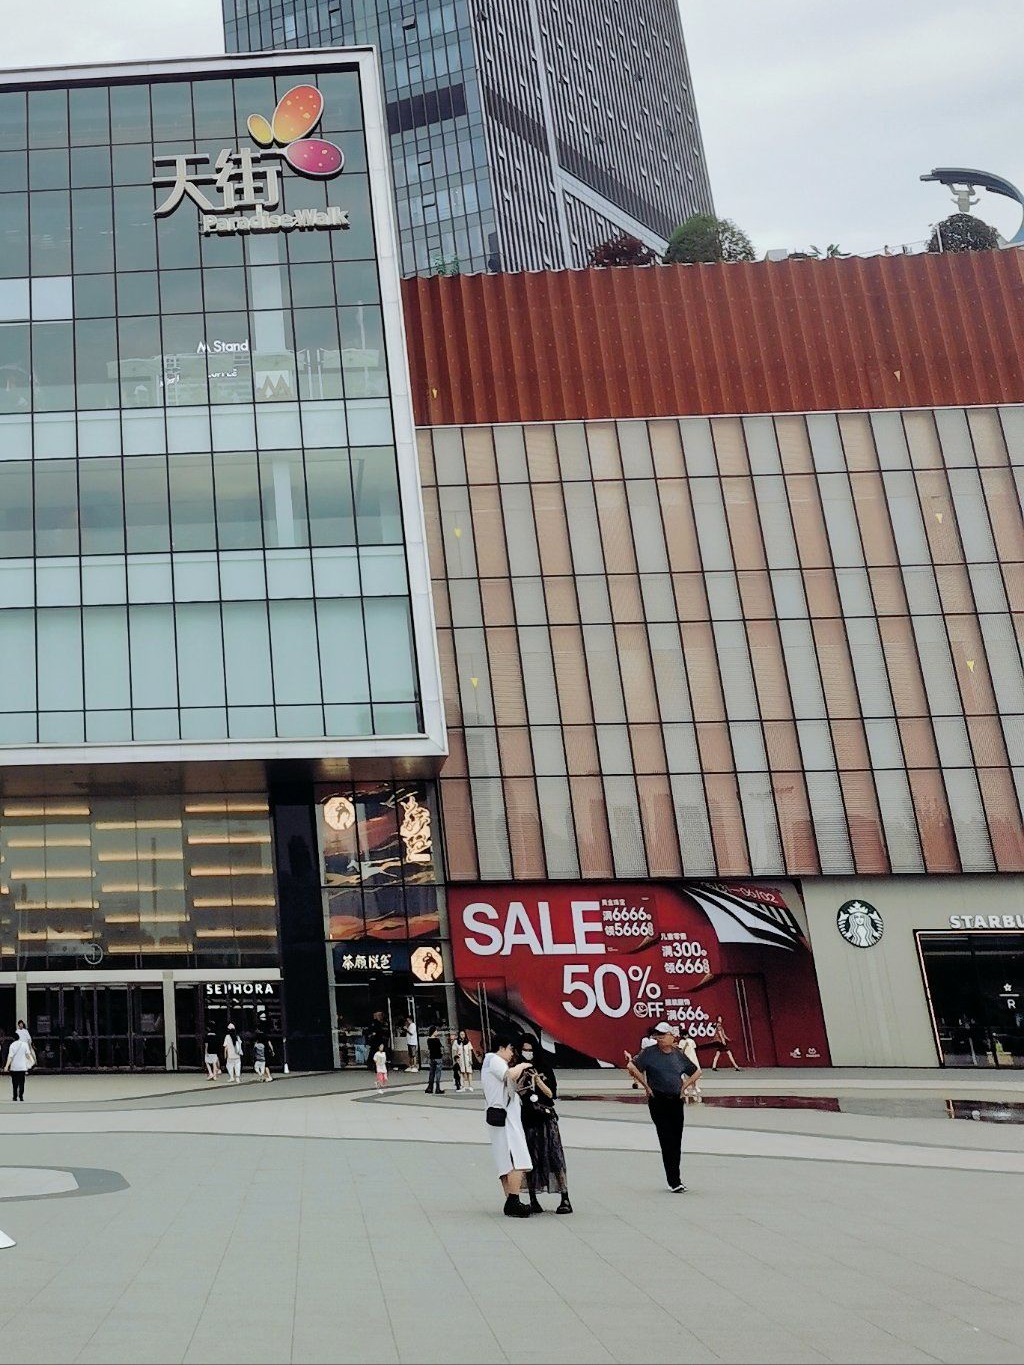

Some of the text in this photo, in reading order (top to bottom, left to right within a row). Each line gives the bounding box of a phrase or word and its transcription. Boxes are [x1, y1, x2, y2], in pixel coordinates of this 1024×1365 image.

[151, 147, 283, 217] 天街
[294, 206, 350, 229] Walk
[214, 339, 249, 353] Stand
[462, 901, 606, 956] SALE
[206, 983, 274, 995] SEPHORA
[562, 963, 662, 1019] 50%
